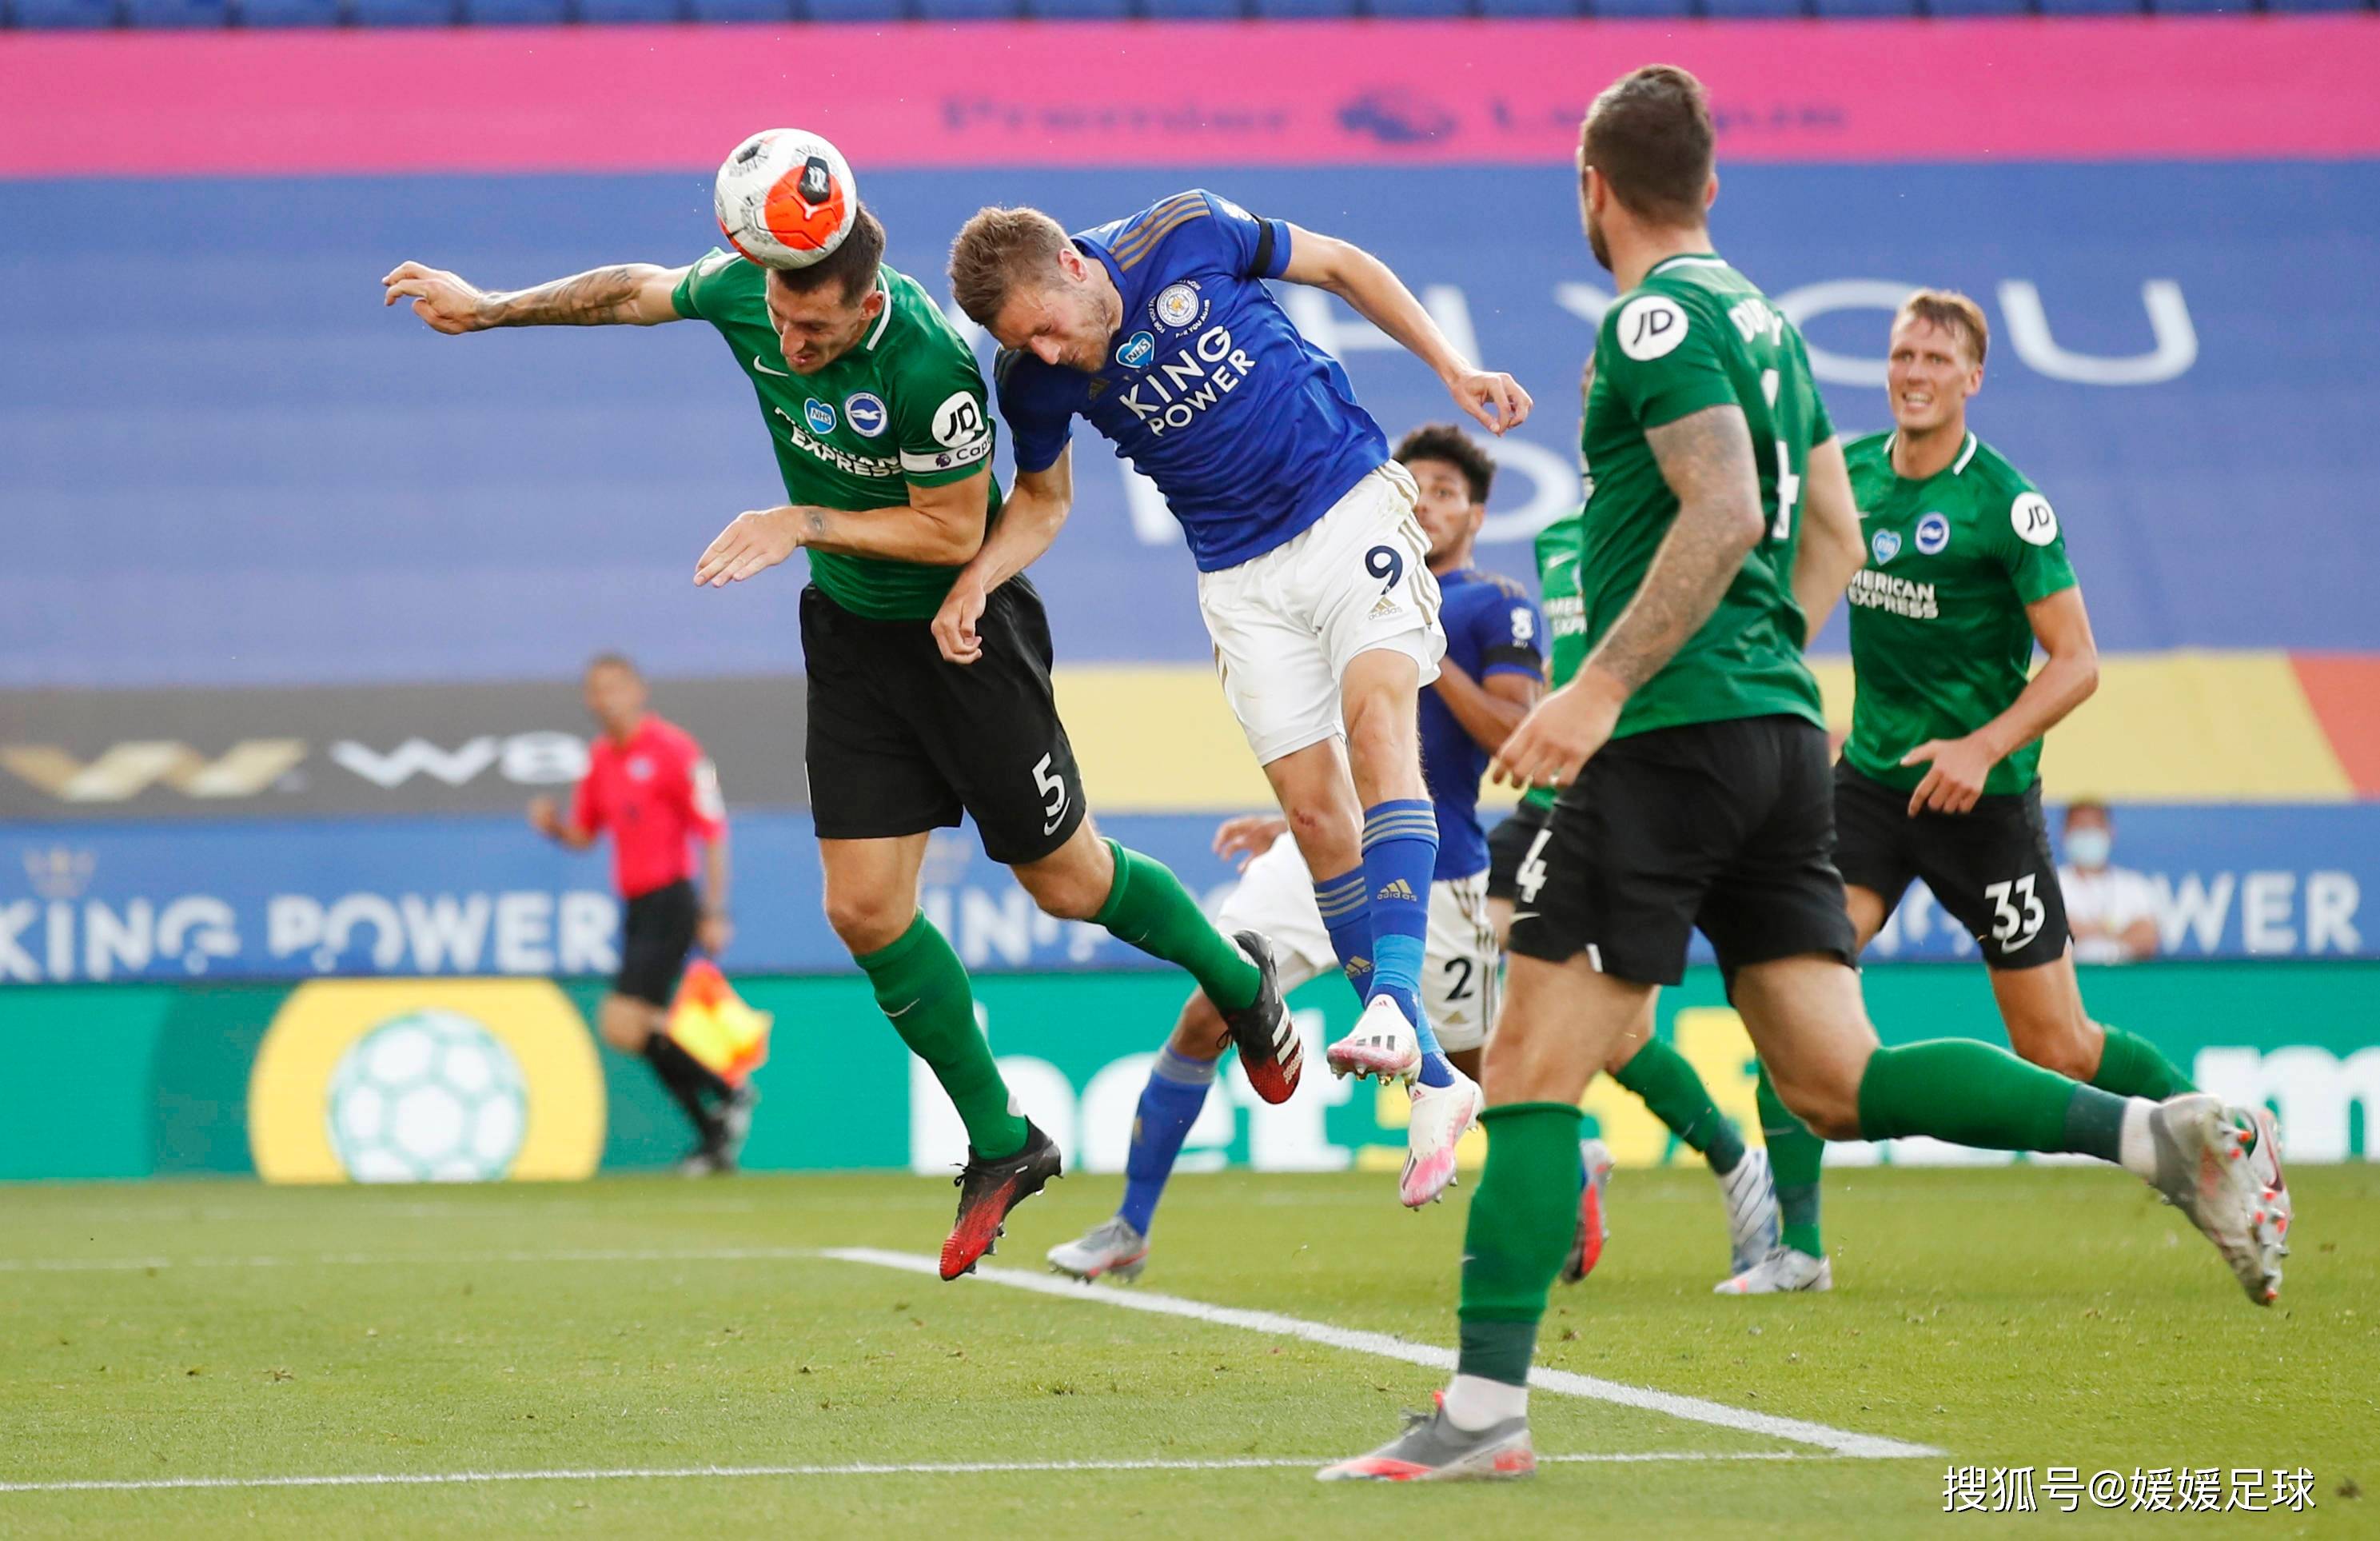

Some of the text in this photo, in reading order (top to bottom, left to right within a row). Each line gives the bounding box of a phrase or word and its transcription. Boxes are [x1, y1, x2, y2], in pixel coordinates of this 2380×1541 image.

[1127, 338, 1150, 362] NHS
[1633, 308, 1674, 346] JD
[1118, 325, 1232, 421] KING
[1147, 348, 1256, 437] POWER
[811, 408, 832, 426] NHS
[943, 401, 977, 442] JD
[790, 425, 903, 477] EXPRESS
[2026, 504, 2051, 534] JD
[1365, 545, 1403, 595] 9
[1851, 569, 1935, 602] MERICAN
[1031, 751, 1066, 818] 5
[1516, 827, 1554, 904] 4
[1377, 891, 1417, 902] adidas
[1983, 872, 2047, 940] 33
[2156, 872, 2362, 954] WER
[0, 891, 623, 983] KING POWER
[1444, 956, 1473, 1002] 2
